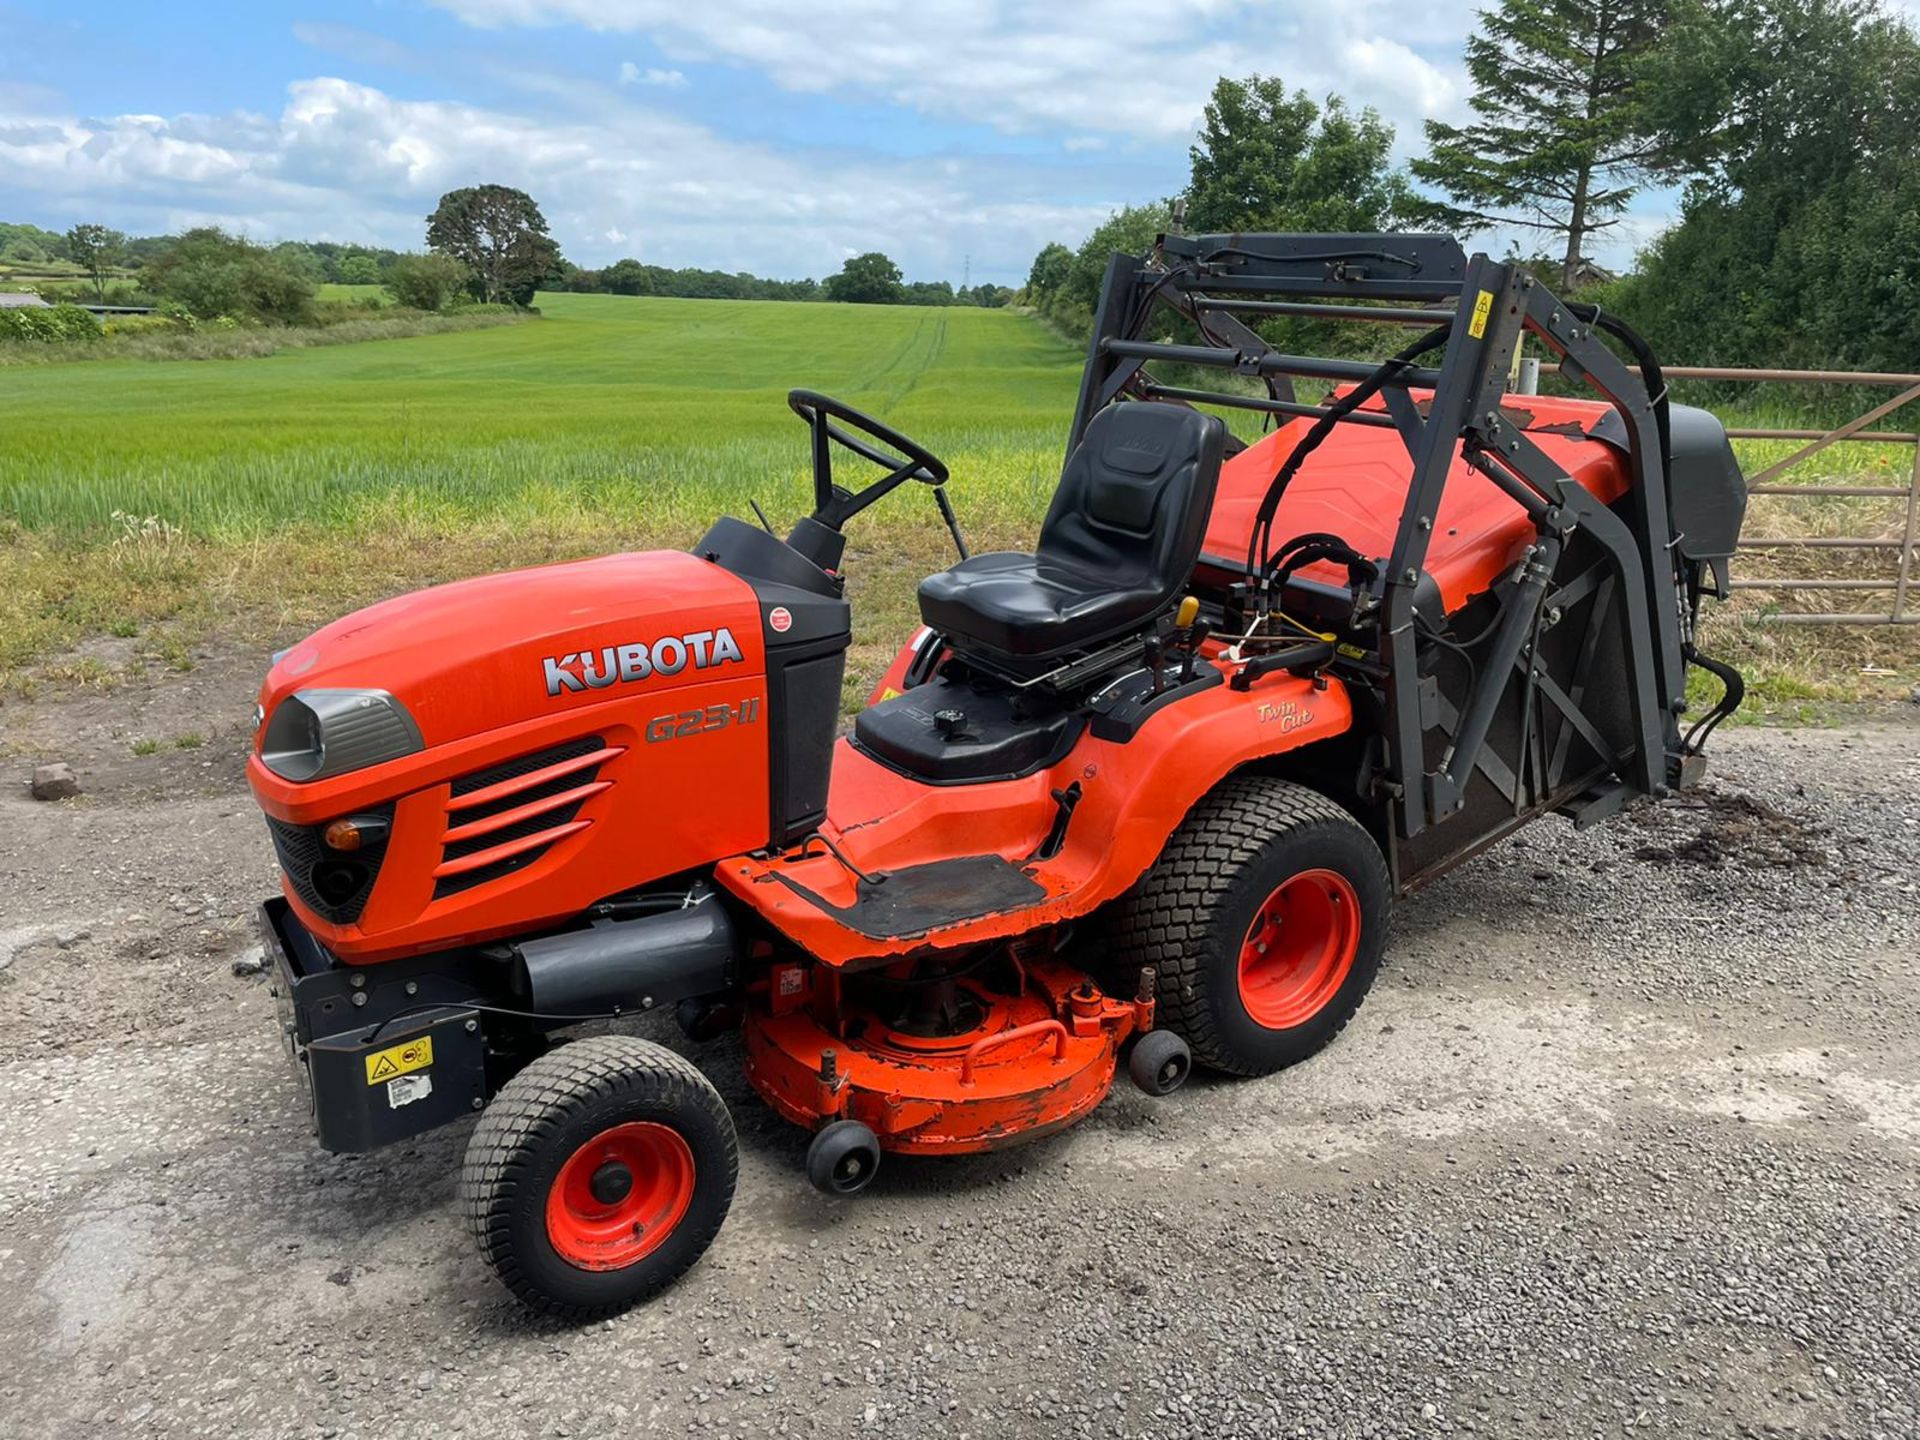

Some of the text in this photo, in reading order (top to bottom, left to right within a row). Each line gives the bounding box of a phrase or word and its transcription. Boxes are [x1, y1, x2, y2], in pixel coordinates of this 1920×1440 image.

[542, 628, 744, 696] KUBOTA
[1258, 702, 1296, 723] Twin
[1281, 710, 1314, 733] Cut
